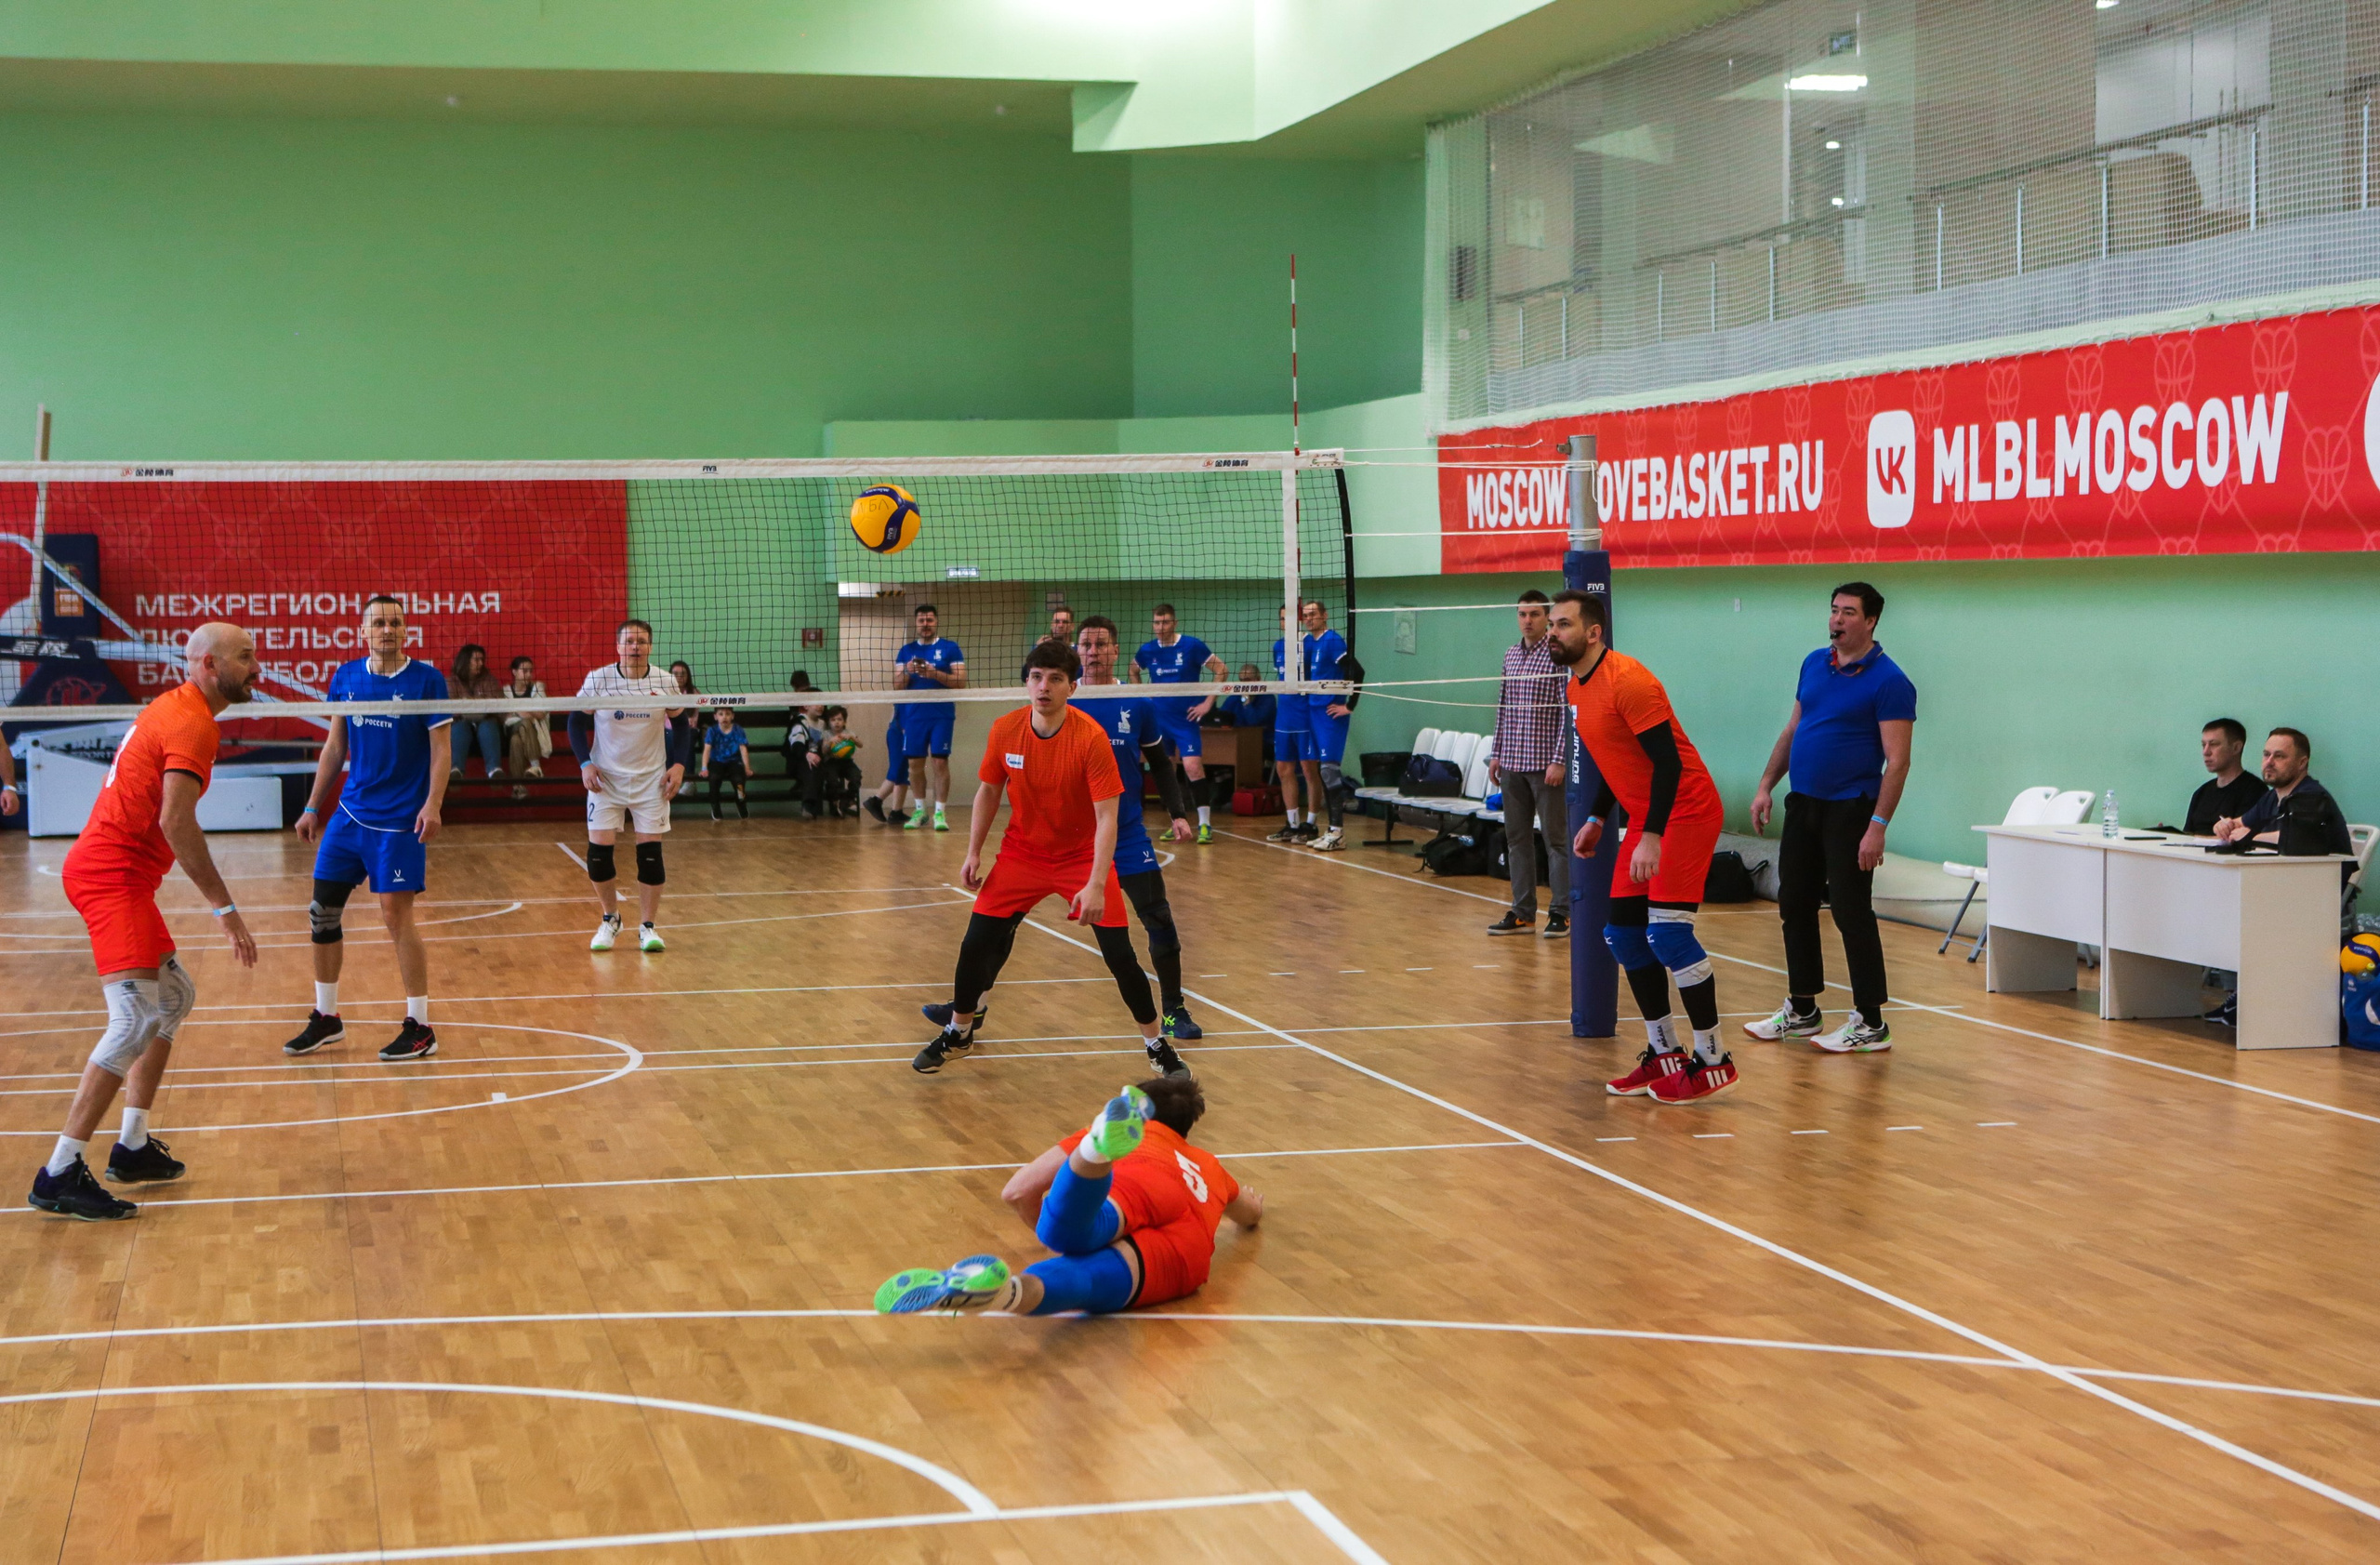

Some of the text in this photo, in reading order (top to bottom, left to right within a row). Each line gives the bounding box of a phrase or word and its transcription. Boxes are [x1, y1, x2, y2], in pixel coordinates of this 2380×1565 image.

[1933, 391, 2289, 504] MLBLMOSCOW
[1466, 438, 1824, 529] MOSCOW.OVEBASKET.RU
[1874, 445, 1907, 496] VK
[1587, 583, 1605, 591] FIVB
[135, 591, 501, 617] МЕЖРЕГИОНЛЬНАЯ
[364, 718, 392, 729] РОССЕТИ
[588, 802, 595, 822] 2
